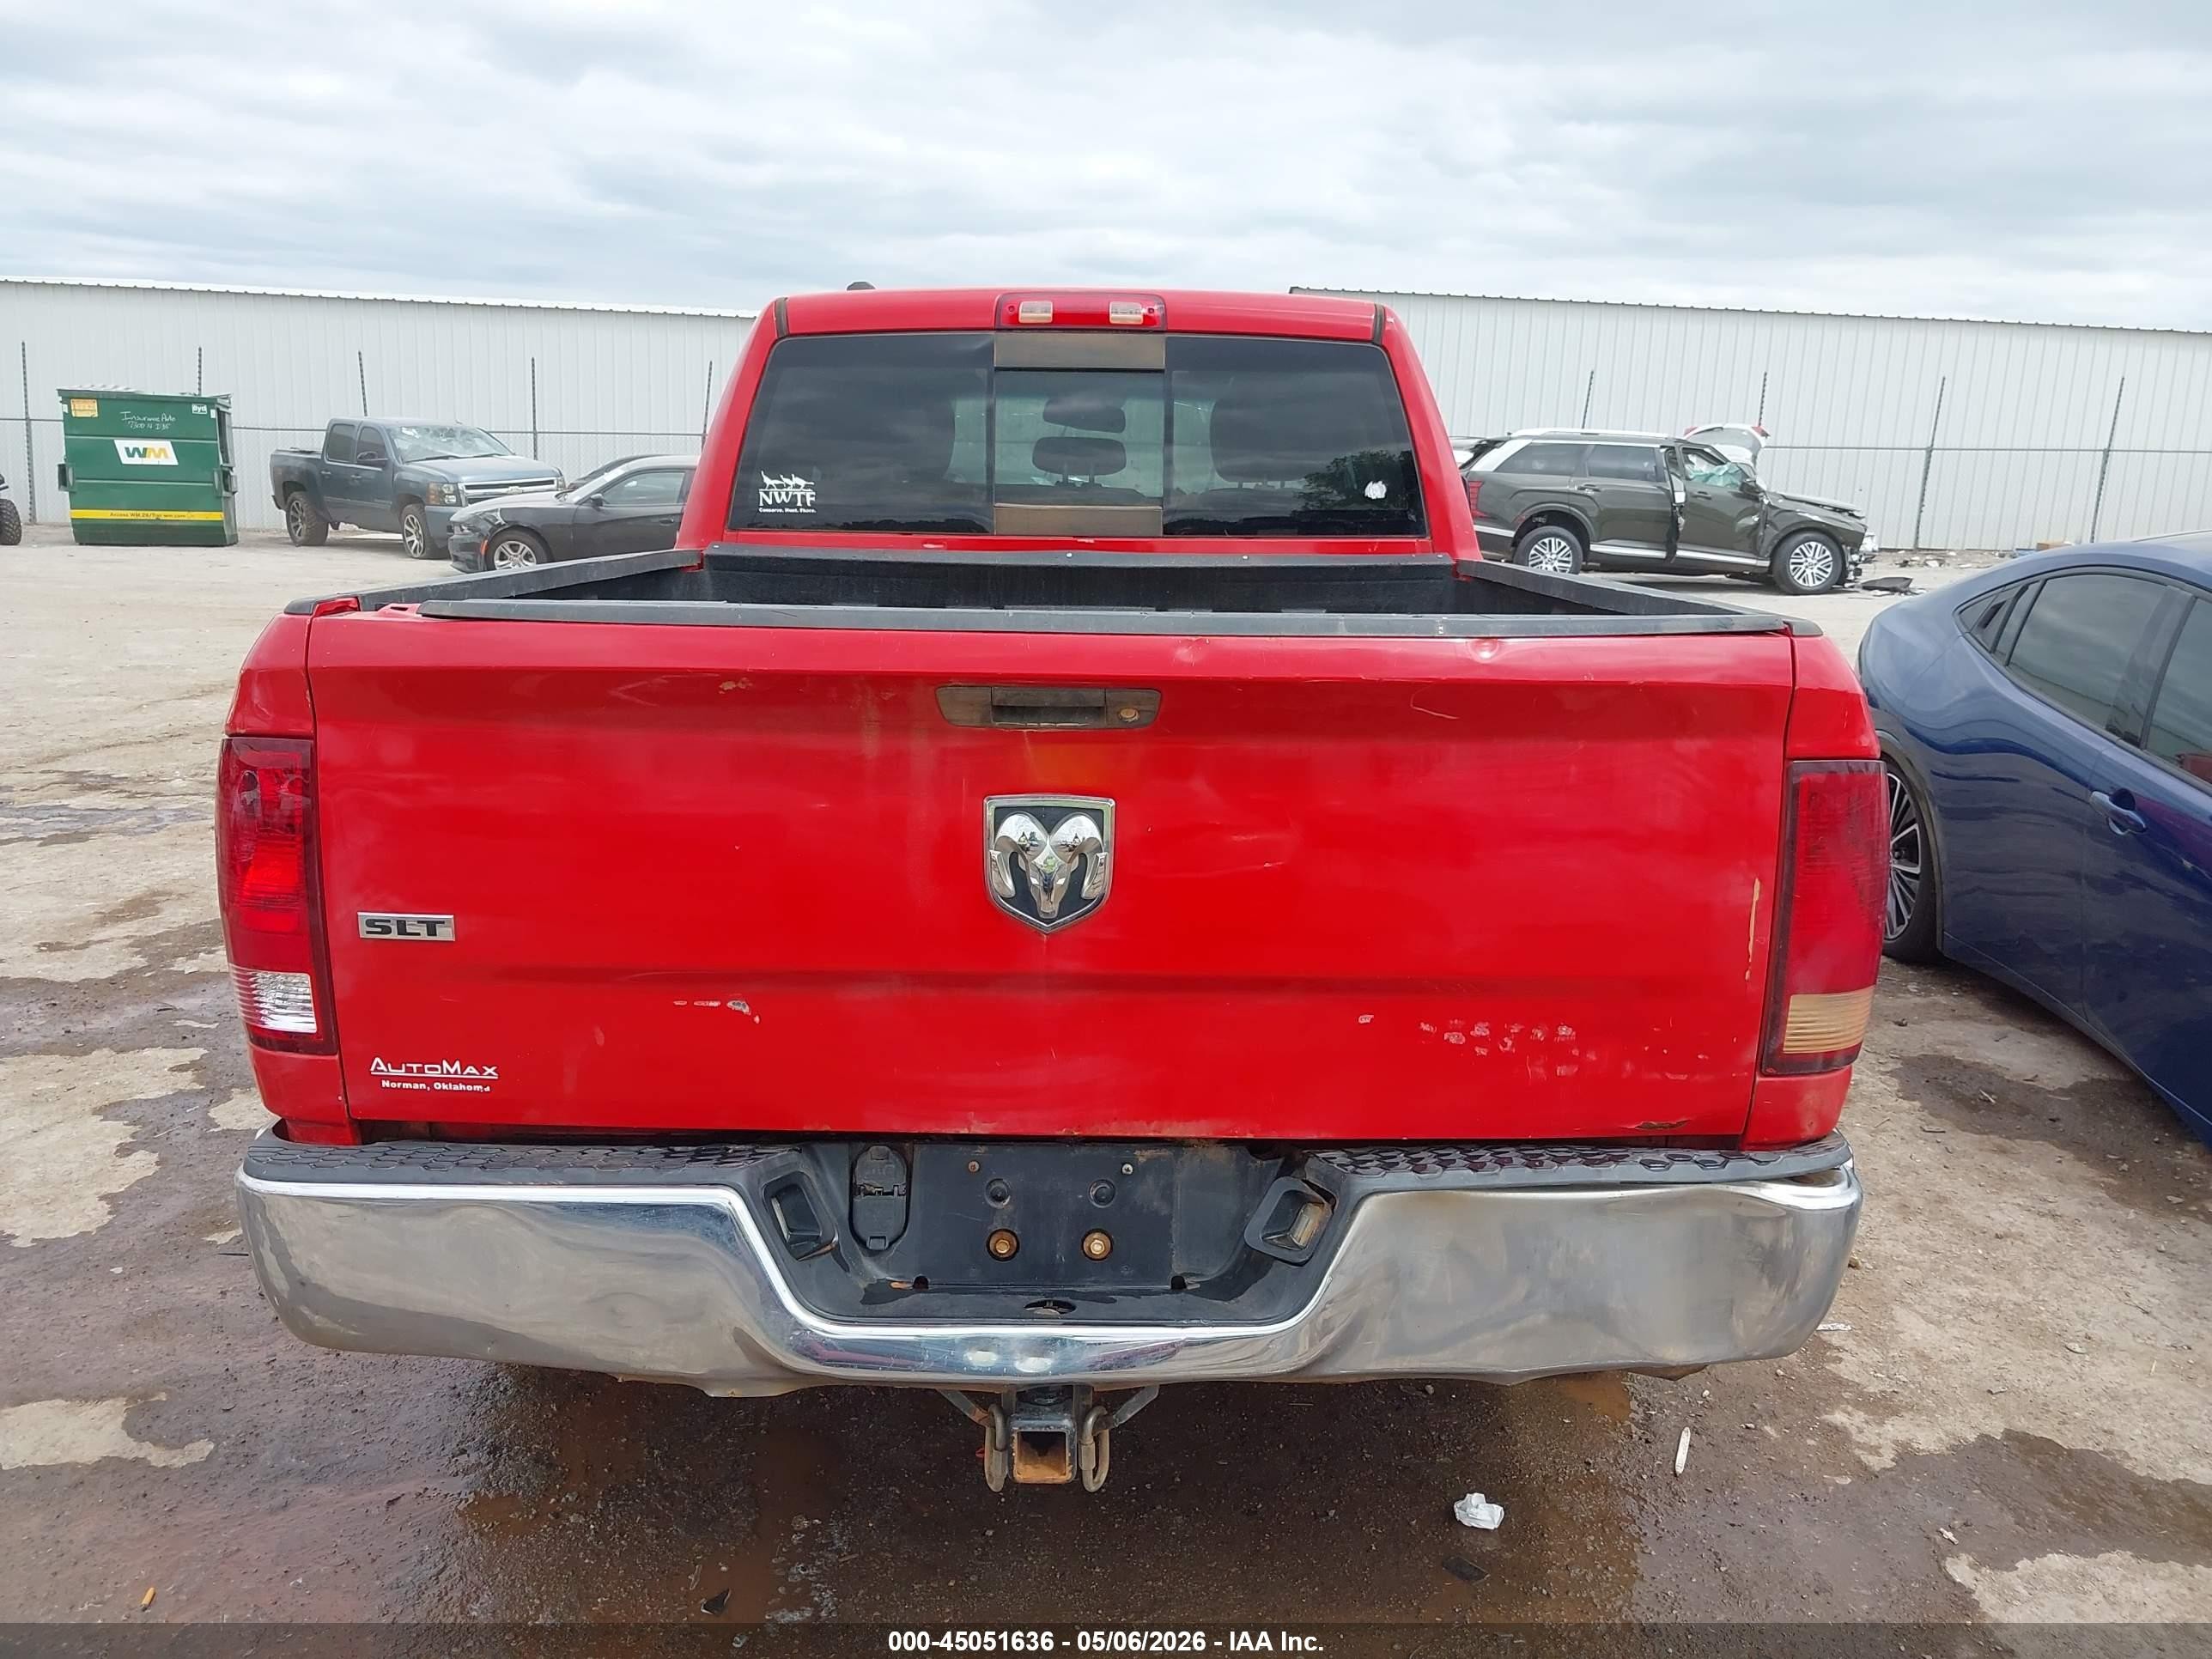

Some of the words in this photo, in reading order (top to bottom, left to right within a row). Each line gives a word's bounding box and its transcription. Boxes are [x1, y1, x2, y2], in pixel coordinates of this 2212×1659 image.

[124, 447, 169, 459] WM
[758, 491, 816, 507] NWTF
[365, 919, 446, 937] SLT
[381, 1079, 430, 1091] Norman,
